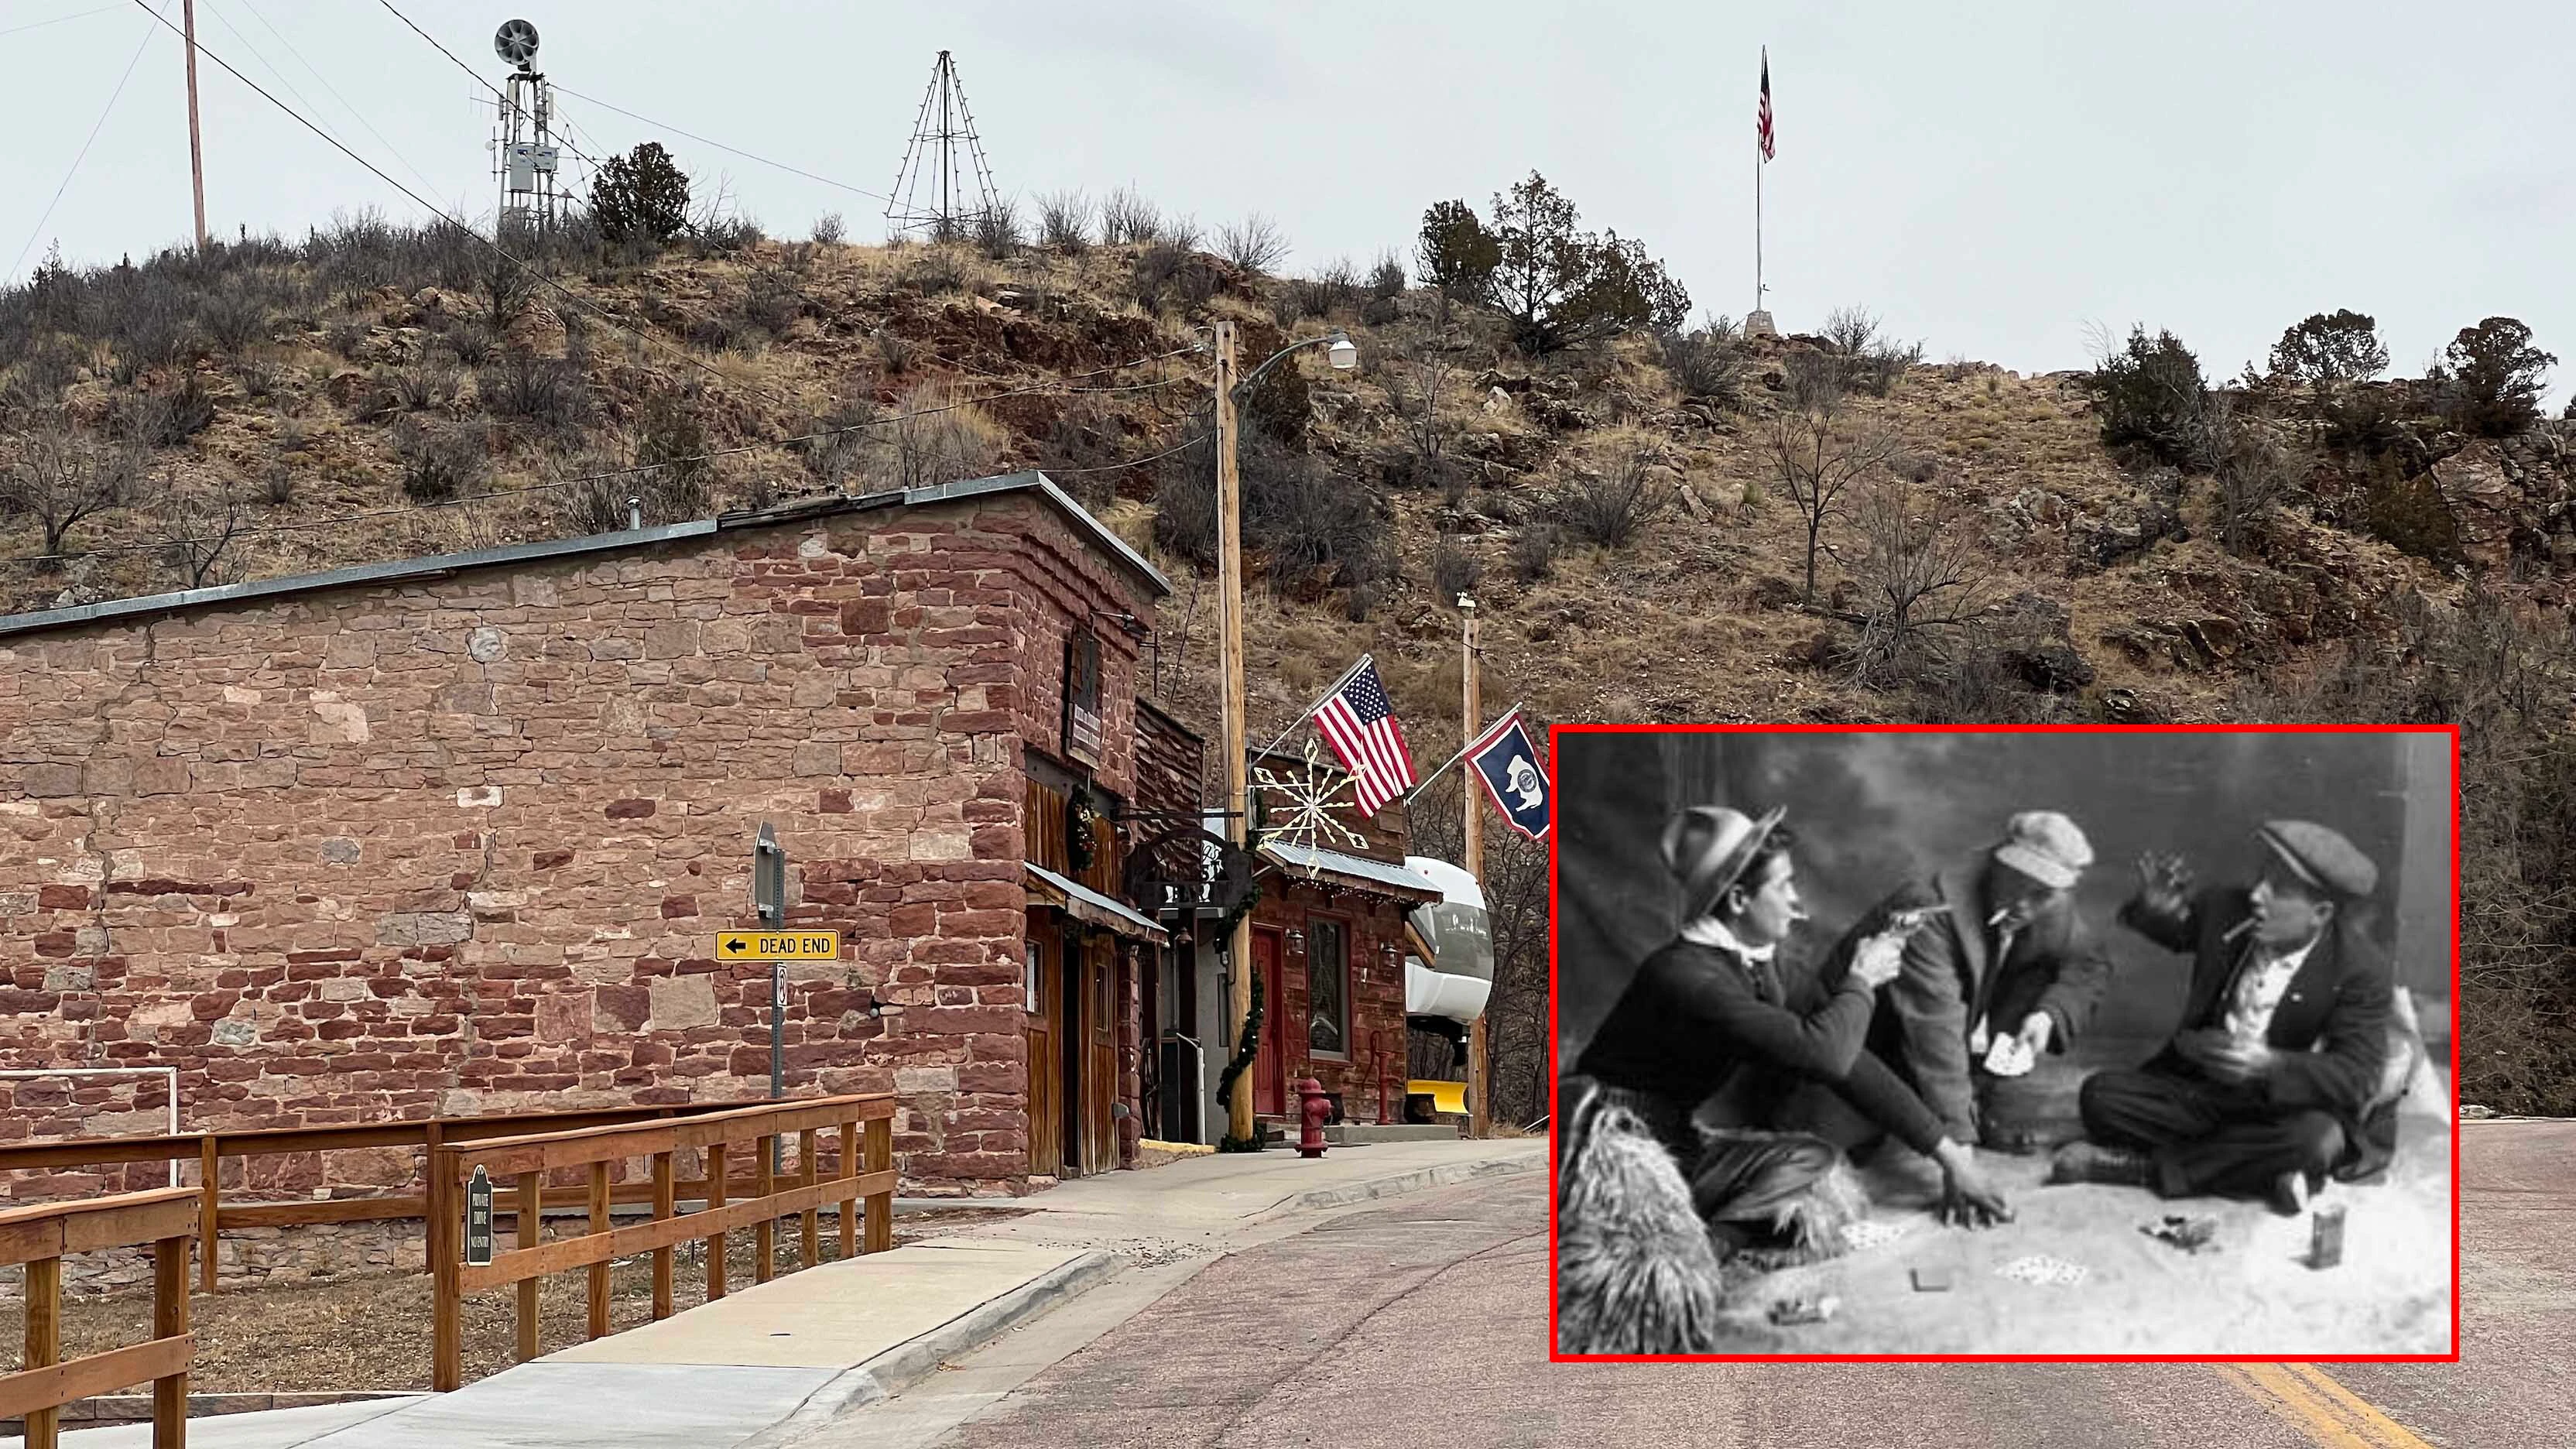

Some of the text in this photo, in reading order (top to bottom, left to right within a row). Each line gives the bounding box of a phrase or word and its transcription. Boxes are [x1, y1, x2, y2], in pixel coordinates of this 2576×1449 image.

[760, 938, 830, 954] DEAD END
[472, 1193, 489, 1208] PRIVATE
[473, 1211, 487, 1225] DRIVE
[471, 1236, 489, 1248] NO ENTRY
